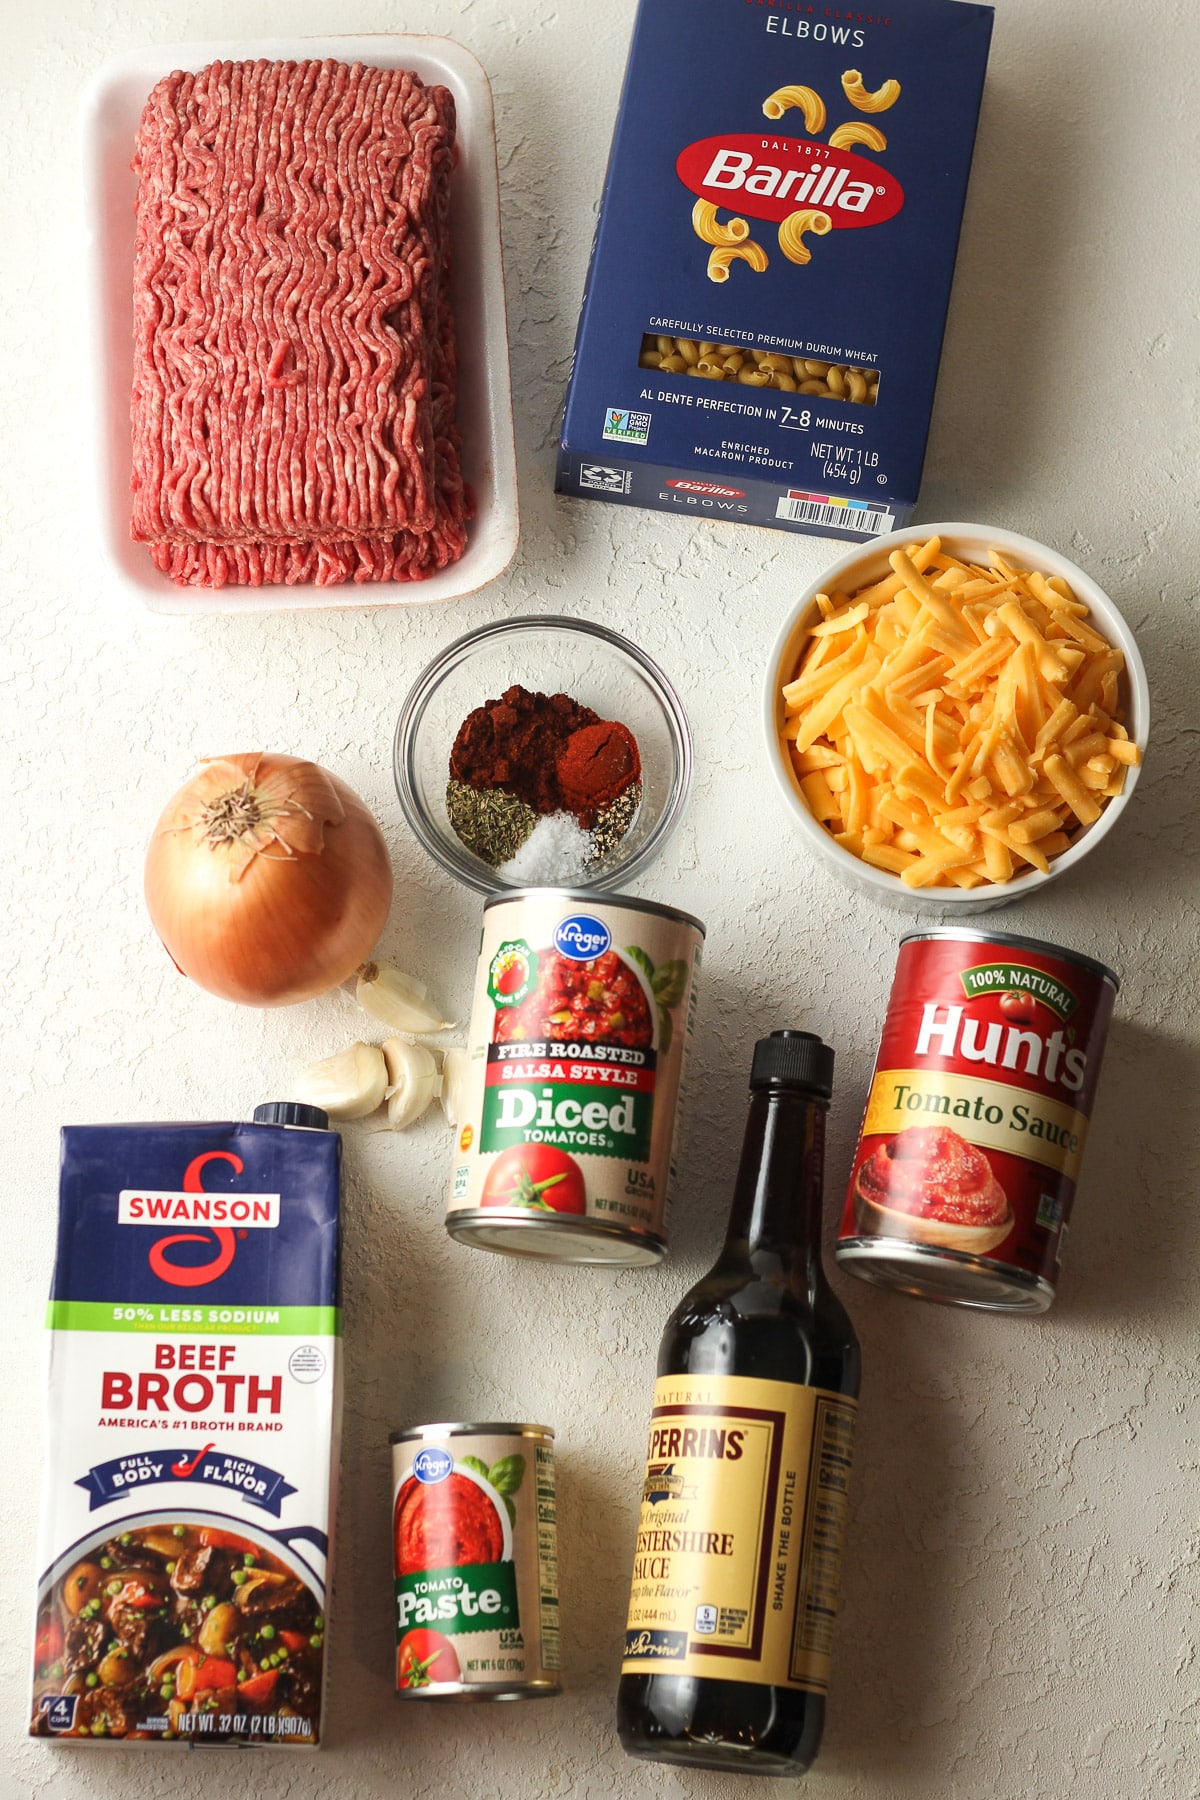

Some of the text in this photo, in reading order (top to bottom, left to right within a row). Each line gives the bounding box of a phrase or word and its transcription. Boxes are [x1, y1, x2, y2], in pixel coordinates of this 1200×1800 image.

[824, 8, 892, 27] CLASSIC
[766, 16, 865, 48] ELBOWS
[762, 140, 830, 159] DAL 1877
[649, 317, 878, 363] CAREFULLY SELECTED PREMIUM DURUM WHEAT
[640, 389, 865, 435] AL DENTE PERFECTION IN 7-8 MINUTES
[607, 428, 645, 439] VERIFIED
[694, 447, 794, 470] MACARONI PRODUCT
[722, 441, 770, 456] ENRICHED
[811, 442, 833, 459] NET
[857, 451, 862, 464] 1
[865, 451, 879, 467] LB
[659, 493, 747, 512] ELBOWS
[558, 922, 607, 951] Kroger
[969, 969, 1071, 1012] 100% NATURAL
[497, 1043, 547, 1060] FIRE
[551, 1043, 645, 1065] ROASTED
[501, 1064, 637, 1085] SALSA STYLE
[496, 1088, 636, 1135] Diced
[894, 1085, 1078, 1153] Tomato Sauce
[524, 1130, 607, 1146] TOMATOES
[628, 1168, 655, 1192] USA
[129, 1197, 270, 1221] SWANSON
[113, 1307, 279, 1324] 50% LESS SODIUM
[155, 1344, 236, 1371] BEEF
[101, 1372, 283, 1414] BROTH
[98, 1418, 283, 1431] AMERICA'S #1 BROTH BRAND
[651, 1428, 744, 1460] PERRINS
[119, 1456, 152, 1471] FULL
[224, 1458, 255, 1475] RICH
[416, 1454, 449, 1477] Kroger
[111, 1463, 164, 1487] BODY
[203, 1465, 268, 1496] FLAVOR
[646, 1509, 689, 1528] Original
[773, 1471, 796, 1611] SHAKE THE BOTTLE
[415, 1577, 462, 1594] TOMATO
[641, 1585, 653, 1597] the
[704, 1609, 709, 1619] 5
[500, 1632, 524, 1643] USA
[467, 1660, 478, 1670] NET
[480, 1660, 490, 1670] WT
[54, 1700, 68, 1715] 4
[179, 1714, 196, 1732] NET
[199, 1714, 217, 1732] WT.
[219, 1715, 231, 1732] 32
